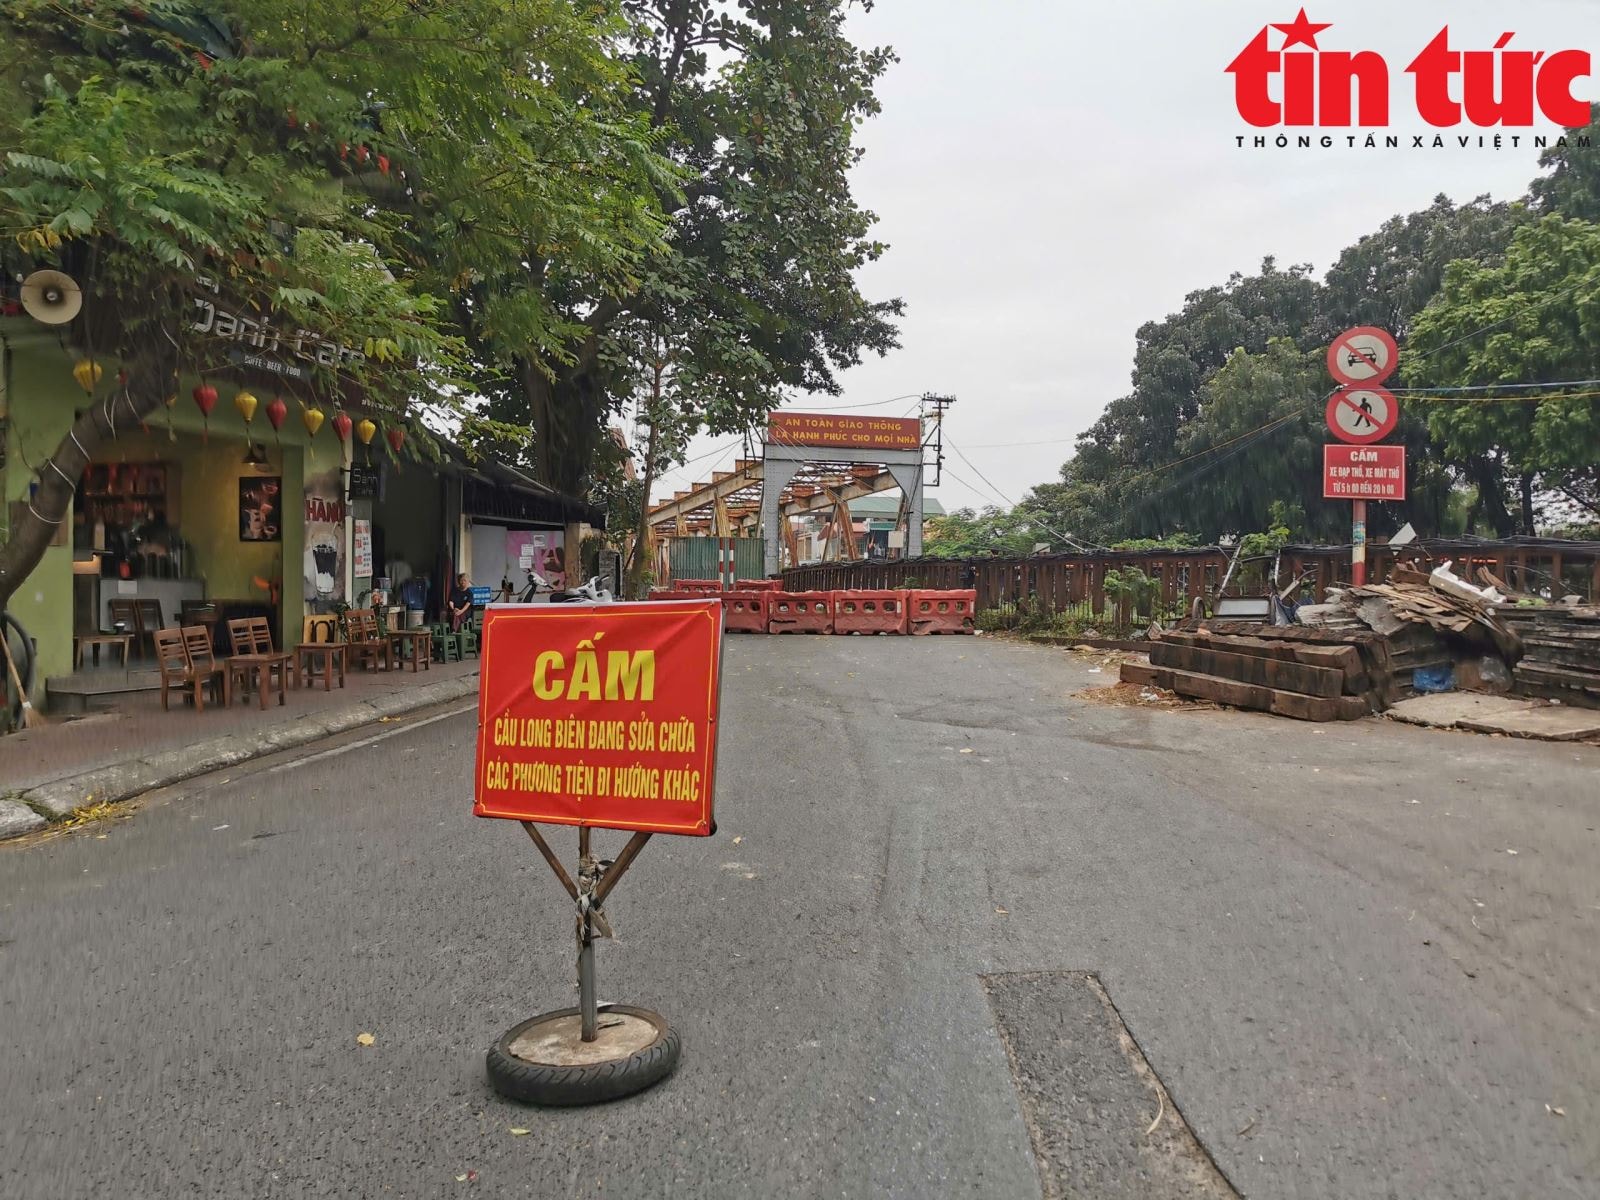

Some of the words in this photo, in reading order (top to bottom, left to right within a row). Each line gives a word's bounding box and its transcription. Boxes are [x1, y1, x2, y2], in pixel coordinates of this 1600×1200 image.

[266, 360, 282, 372] BEER
[286, 366, 301, 377] FOOD
[785, 418, 800, 426] AN
[806, 418, 833, 428] TOÀN
[868, 420, 902, 430] THÔNG
[793, 432, 820, 441] HẠNH
[824, 430, 848, 441] PHÚC
[852, 433, 870, 442] CHO
[875, 434, 893, 444] MỌI
[897, 433, 916, 444] NHÀ
[1350, 448, 1378, 462] CẤM
[1329, 466, 1337, 477] XE
[1338, 466, 1350, 479] ĐẠP
[1365, 467, 1373, 478] XE
[1374, 466, 1387, 478] MÁY
[1360, 480, 1372, 494] ĐẾN
[1373, 483, 1380, 494] 20
[532, 632, 655, 701] CẤM
[494, 708, 517, 746] CẦU
[520, 718, 551, 748] LONG
[555, 714, 585, 749] BIÊN
[588, 721, 625, 750] ĐANG
[628, 711, 655, 751] SỬA
[659, 716, 695, 752] CHỮA
[486, 756, 509, 790] CÁC
[512, 761, 561, 794] PHƯƠNG
[566, 760, 594, 801] TIỆN
[597, 767, 611, 797] ĐI
[614, 761, 659, 800] HƯỚNG
[663, 763, 700, 802] KHÁC
